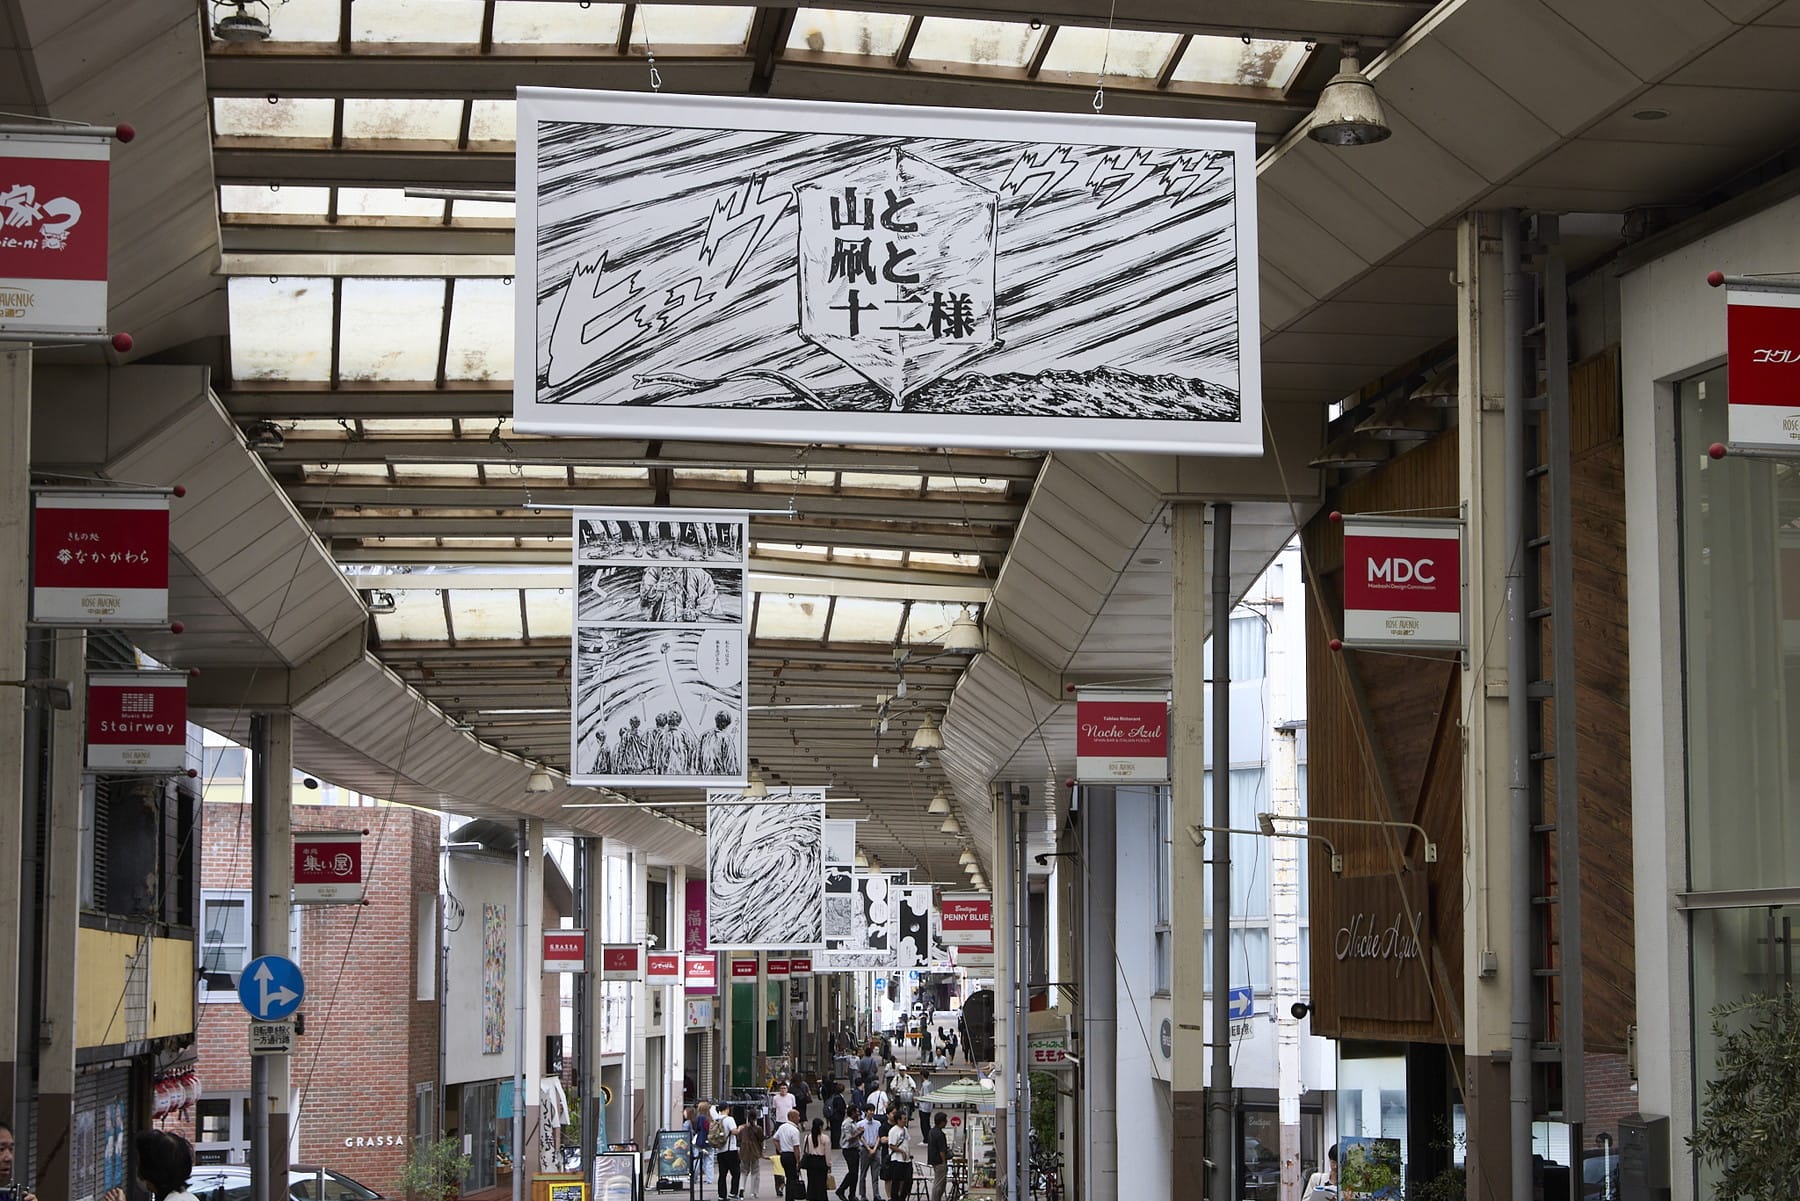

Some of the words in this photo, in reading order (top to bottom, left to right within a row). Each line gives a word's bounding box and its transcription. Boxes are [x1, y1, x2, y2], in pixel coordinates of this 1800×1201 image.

[830, 187, 919, 233] 山と
[829, 289, 975, 339] 十二様
[75, 549, 149, 565] なかがわら
[1367, 557, 1436, 583] MDC
[100, 721, 174, 735] Stairway
[1081, 724, 1125, 738] Noche
[1127, 725, 1162, 738] Azul
[944, 913, 968, 921] PENNY
[969, 913, 989, 921] BLUE
[1335, 913, 1381, 960] Noche
[345, 1136, 404, 1148] GRASSA
